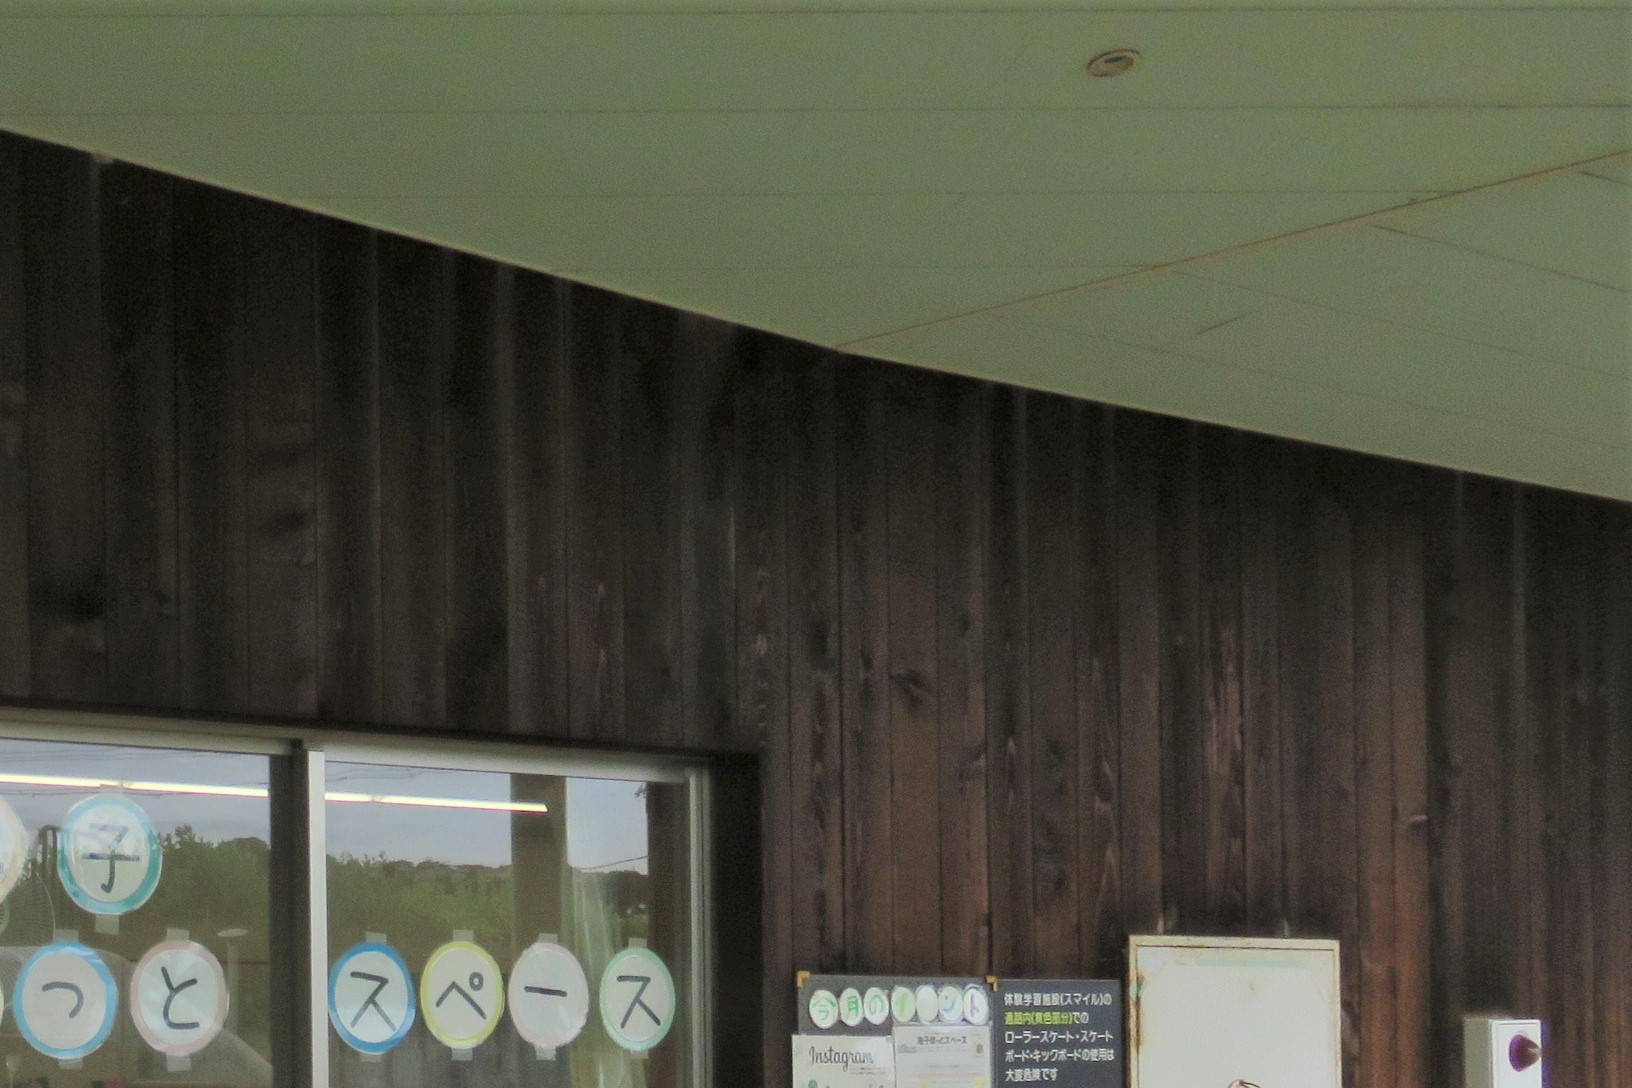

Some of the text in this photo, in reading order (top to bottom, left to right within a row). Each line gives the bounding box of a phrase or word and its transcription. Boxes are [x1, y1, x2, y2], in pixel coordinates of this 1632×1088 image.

[811, 988, 980, 1021] 今月のイント
[808, 1046, 875, 1073] Instagram
[1005, 1068, 1059, 1082] 大変危険です
